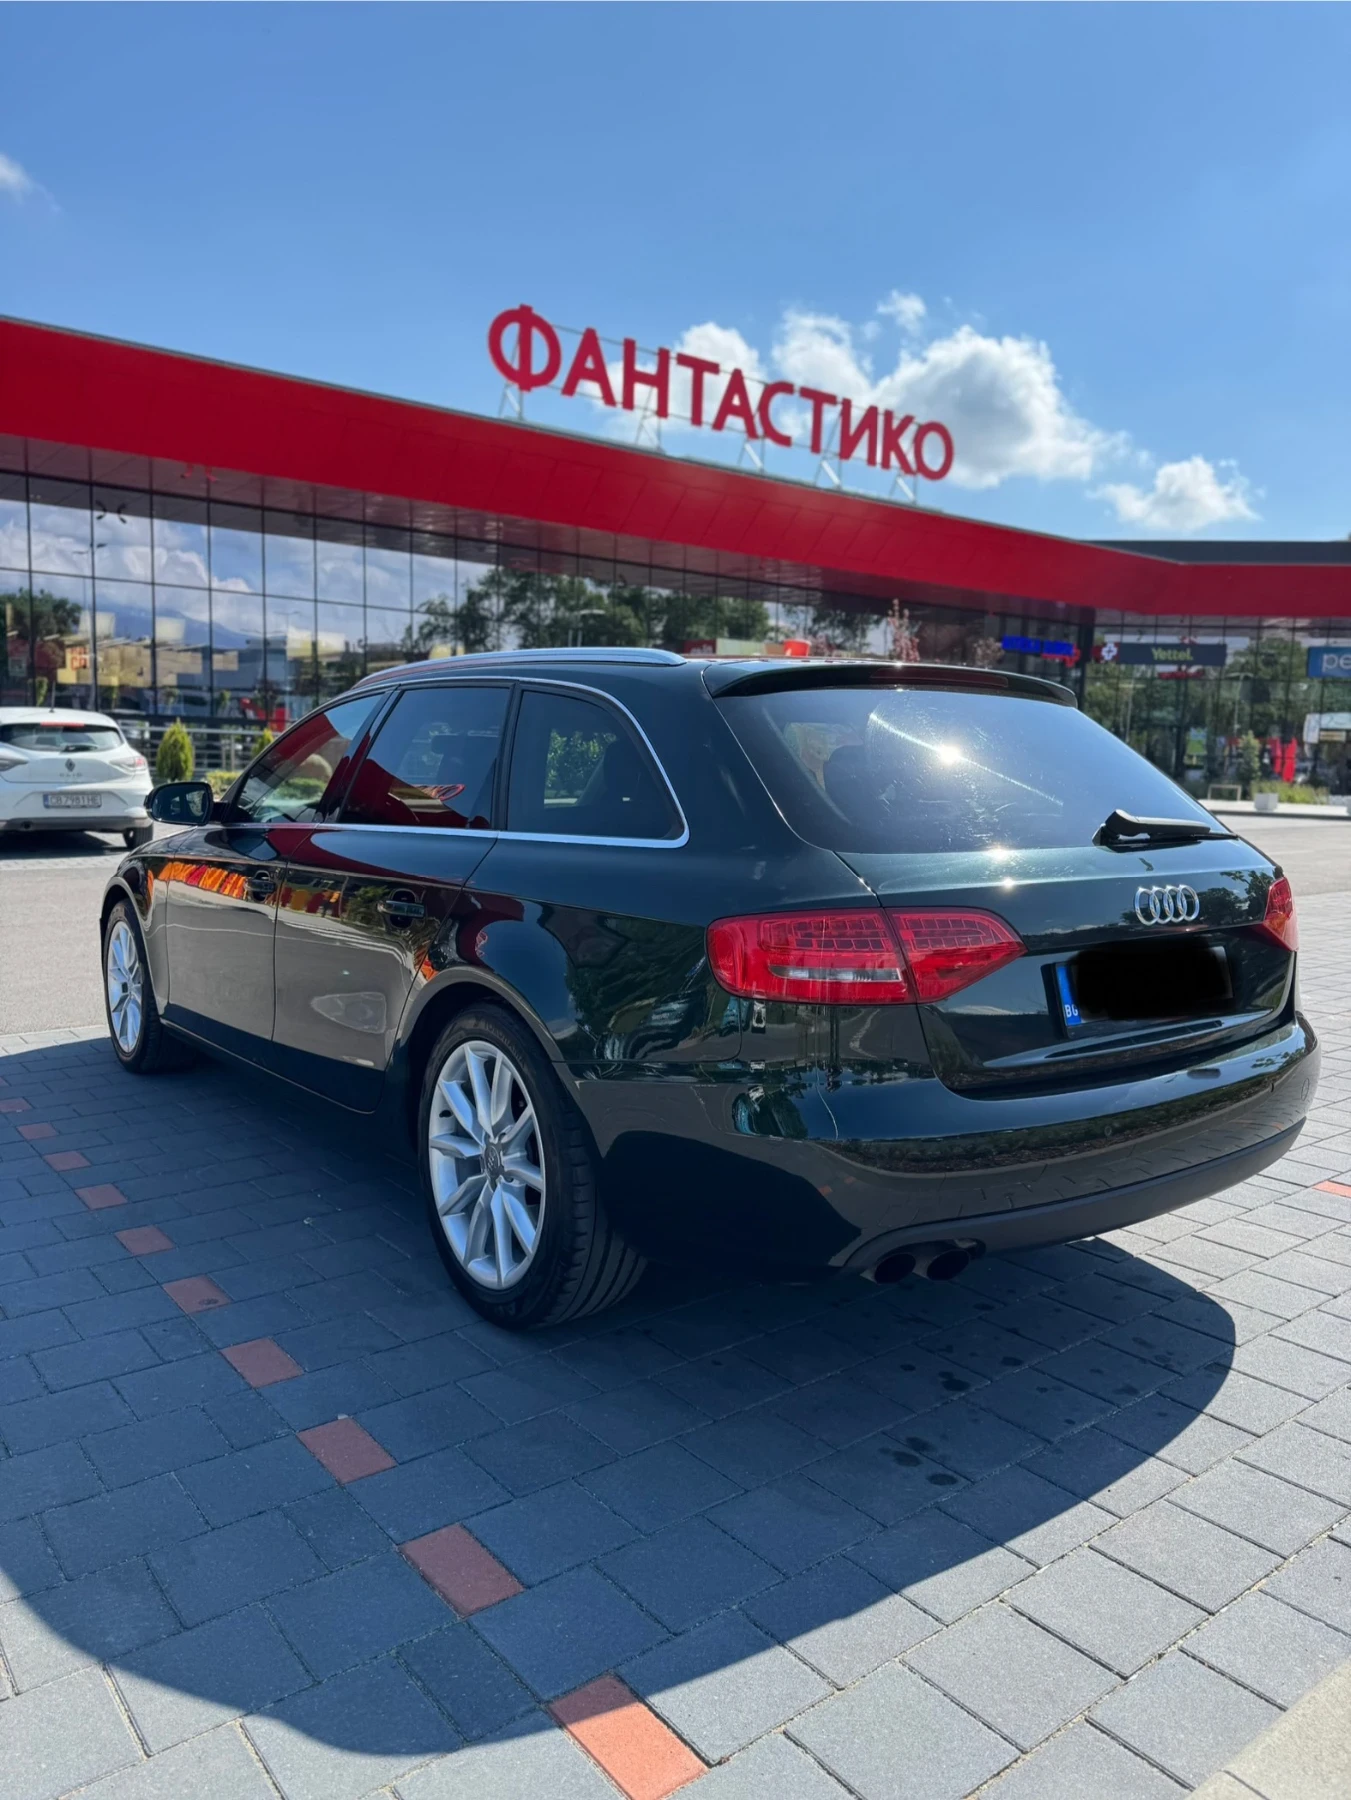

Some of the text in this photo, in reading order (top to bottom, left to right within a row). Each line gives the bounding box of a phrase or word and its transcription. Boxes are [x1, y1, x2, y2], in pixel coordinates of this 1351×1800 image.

[487, 303, 954, 481] ФАНТАСТИКО
[1322, 653, 1351, 673] pe
[1064, 1004, 1079, 1018] BG
